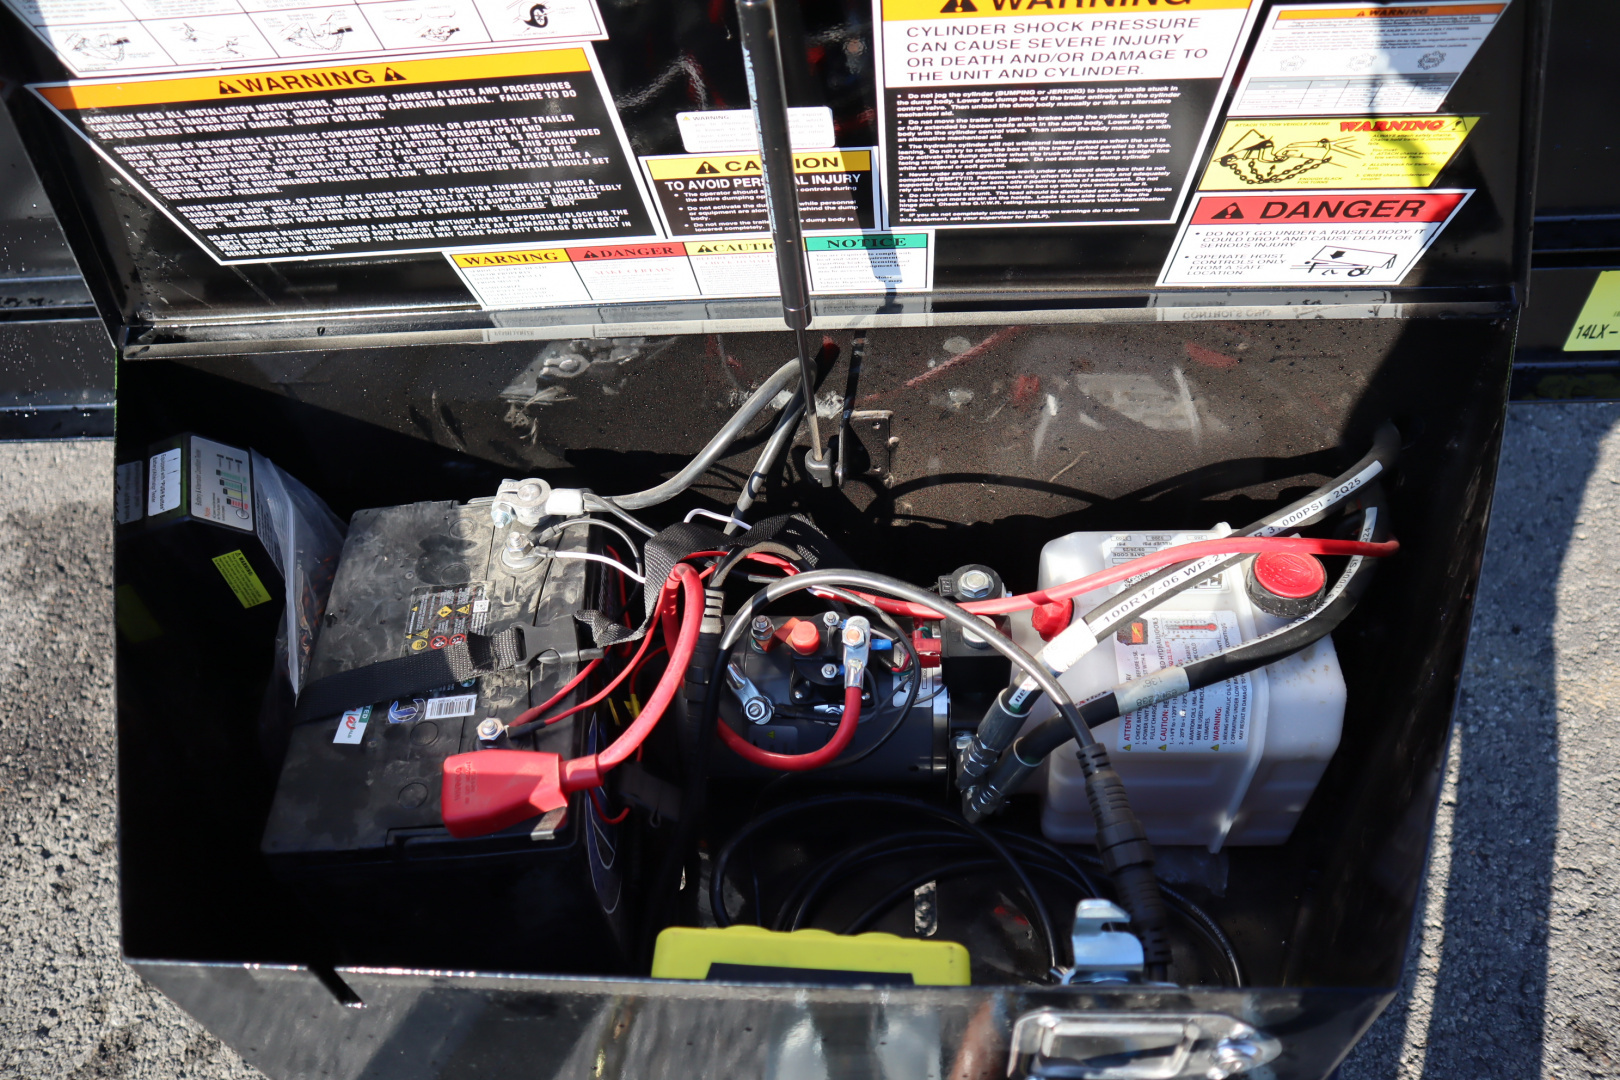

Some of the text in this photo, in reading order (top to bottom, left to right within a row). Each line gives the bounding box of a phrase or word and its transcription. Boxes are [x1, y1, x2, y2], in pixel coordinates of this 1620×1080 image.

[1369, 8, 1428, 17] WARNING
[906, 16, 1201, 38] CYLINDER SHOCK PRESSURE
[906, 33, 1184, 53] CAN CAUSE SEVERE INJURY
[906, 48, 1208, 68] OR DEATH AND/OR DAMAGE TO
[238, 69, 375, 93] WARNING
[906, 64, 1143, 82] THE UNIT AND CYLINDER.
[994, 89, 1035, 97] (BUMPING
[81, 81, 571, 125] CAREFULLY READ ALL INSTALLATION INSTRUCTIONS, WARNINGS, DANGER ALERTS AND PROCEDURES
[98, 111, 384, 140] SO COULD RESULT IN PROPERTY DAMAGE, INJURY OR DEATH.
[1340, 121, 1445, 132] WARNING
[725, 158, 839, 171] CAION
[664, 173, 861, 191] TO AVOID PERSAL INJURY
[700, 190, 731, 198] operator
[1260, 200, 1426, 219] DANGER
[602, 247, 674, 258] DANGER
[714, 243, 774, 252] CAUTI
[827, 238, 907, 248] NOTICE
[464, 252, 558, 265] WARNING
[1104, 576, 1179, 623] 100R17-06
[1268, 501, 1323, 534] 3,000PSI
[1333, 478, 1361, 499] 2Q25
[1224, 697, 1232, 723] HYDRAULIC
[1124, 713, 1132, 741] ATTENTI
[1160, 710, 1169, 741] CAUTION:
[1213, 707, 1222, 741] WARNING:
